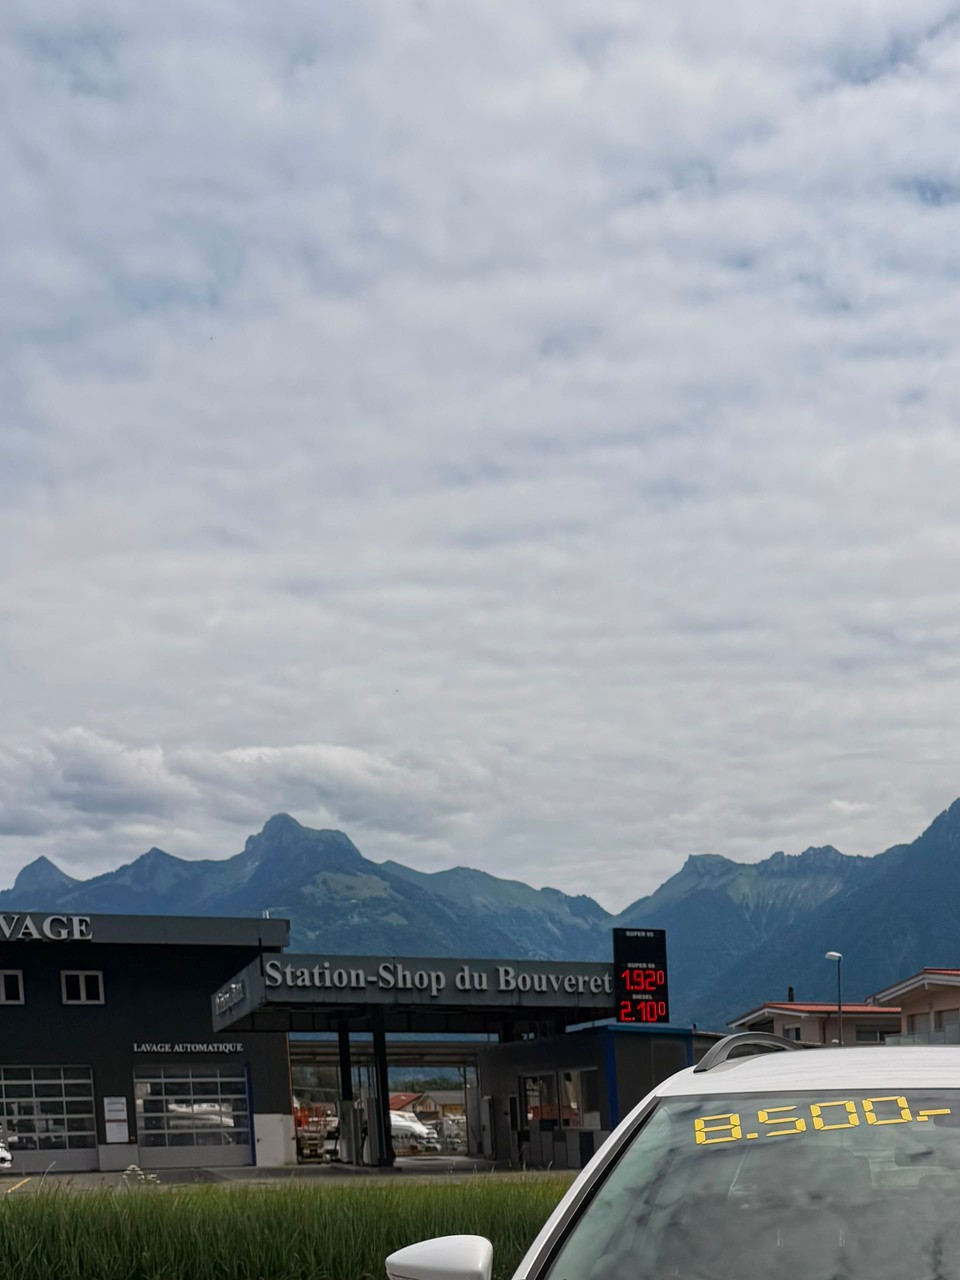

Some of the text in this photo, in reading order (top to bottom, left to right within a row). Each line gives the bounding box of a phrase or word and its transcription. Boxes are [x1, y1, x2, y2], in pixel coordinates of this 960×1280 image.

[0, 914, 93, 940] VAGE
[265, 960, 613, 996] Station-Shop du Bouveret
[133, 1043, 243, 1053] LAVAGE AUTOMATIQUE
